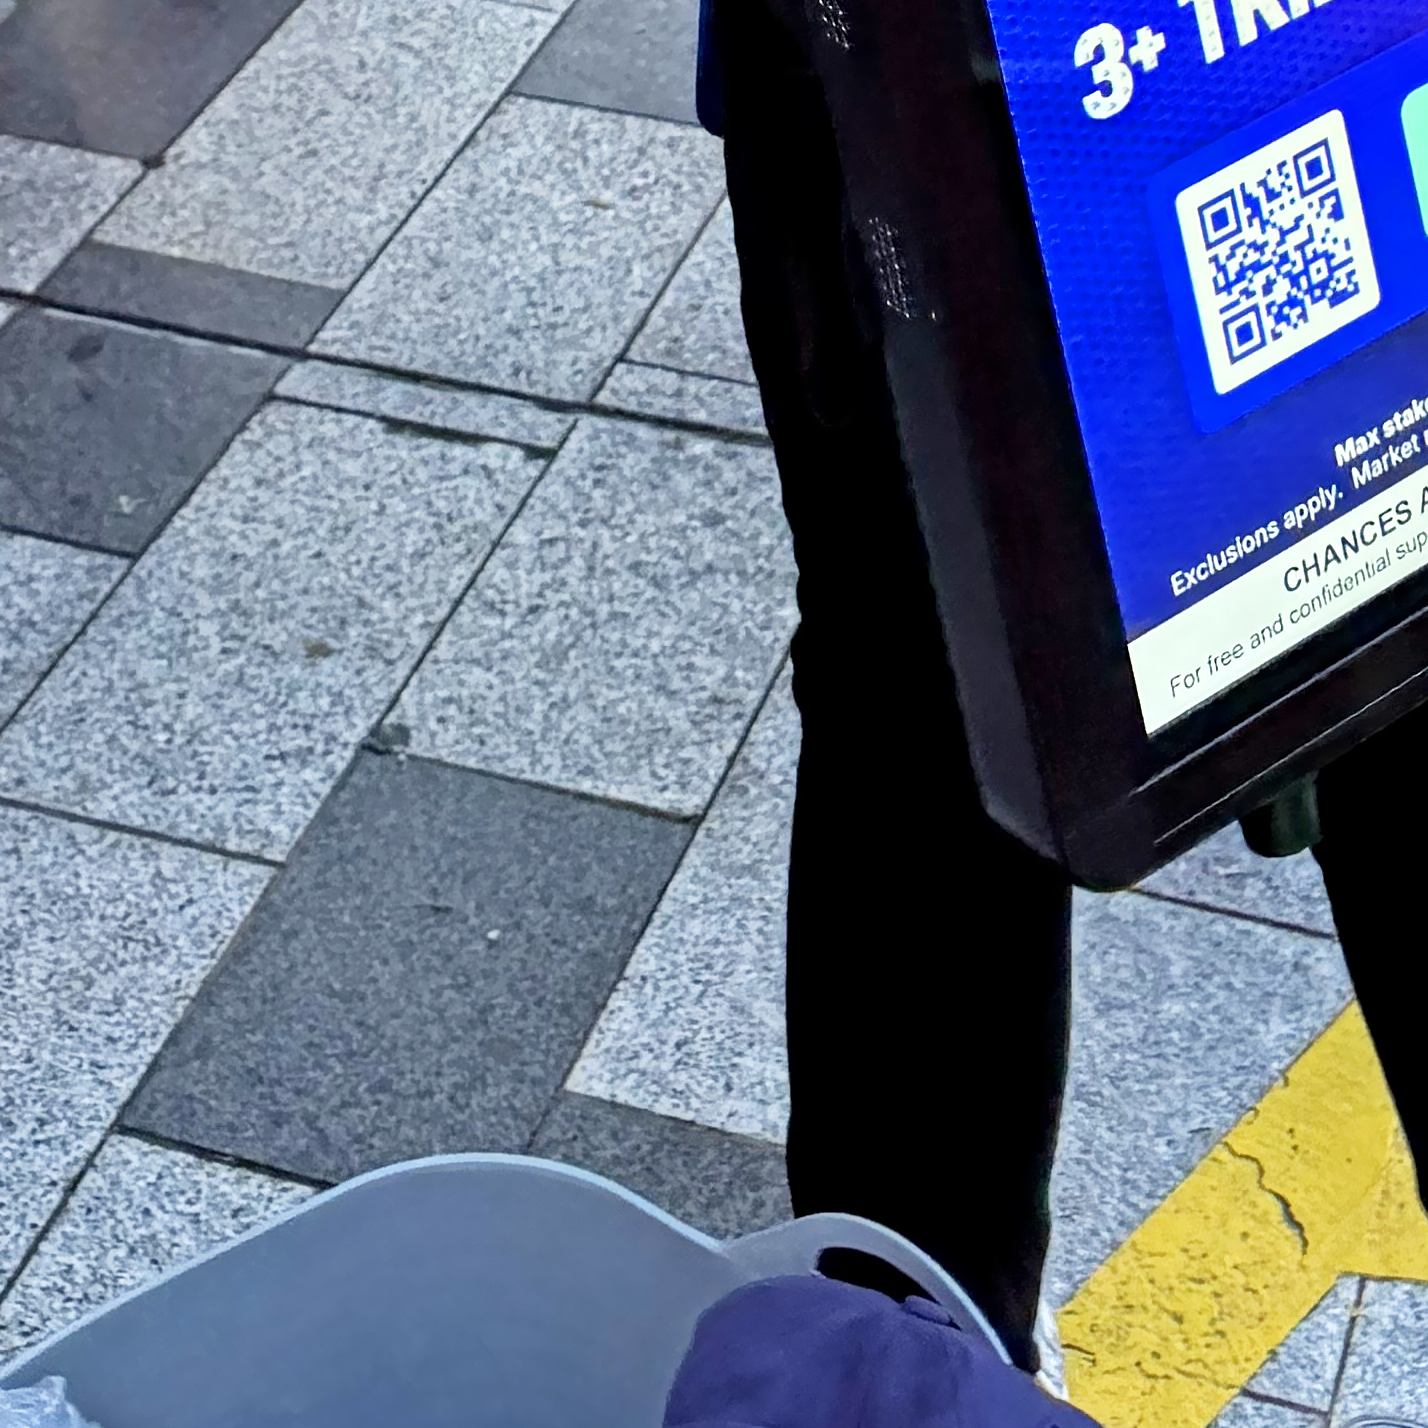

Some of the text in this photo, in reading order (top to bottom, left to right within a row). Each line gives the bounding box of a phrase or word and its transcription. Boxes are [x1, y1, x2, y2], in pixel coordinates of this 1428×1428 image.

[1072, 21, 1167, 121] 3+
[1332, 425, 1383, 469] Max
[1168, 518, 1282, 599] Exclusions
[1281, 482, 1345, 532] apply.
[1349, 432, 1423, 491] Market
[1281, 498, 1414, 594] CHANCES
[1168, 665, 1203, 700] For
[1205, 641, 1246, 677] free
[1248, 611, 1286, 651] and
[1287, 547, 1393, 626] confidential
